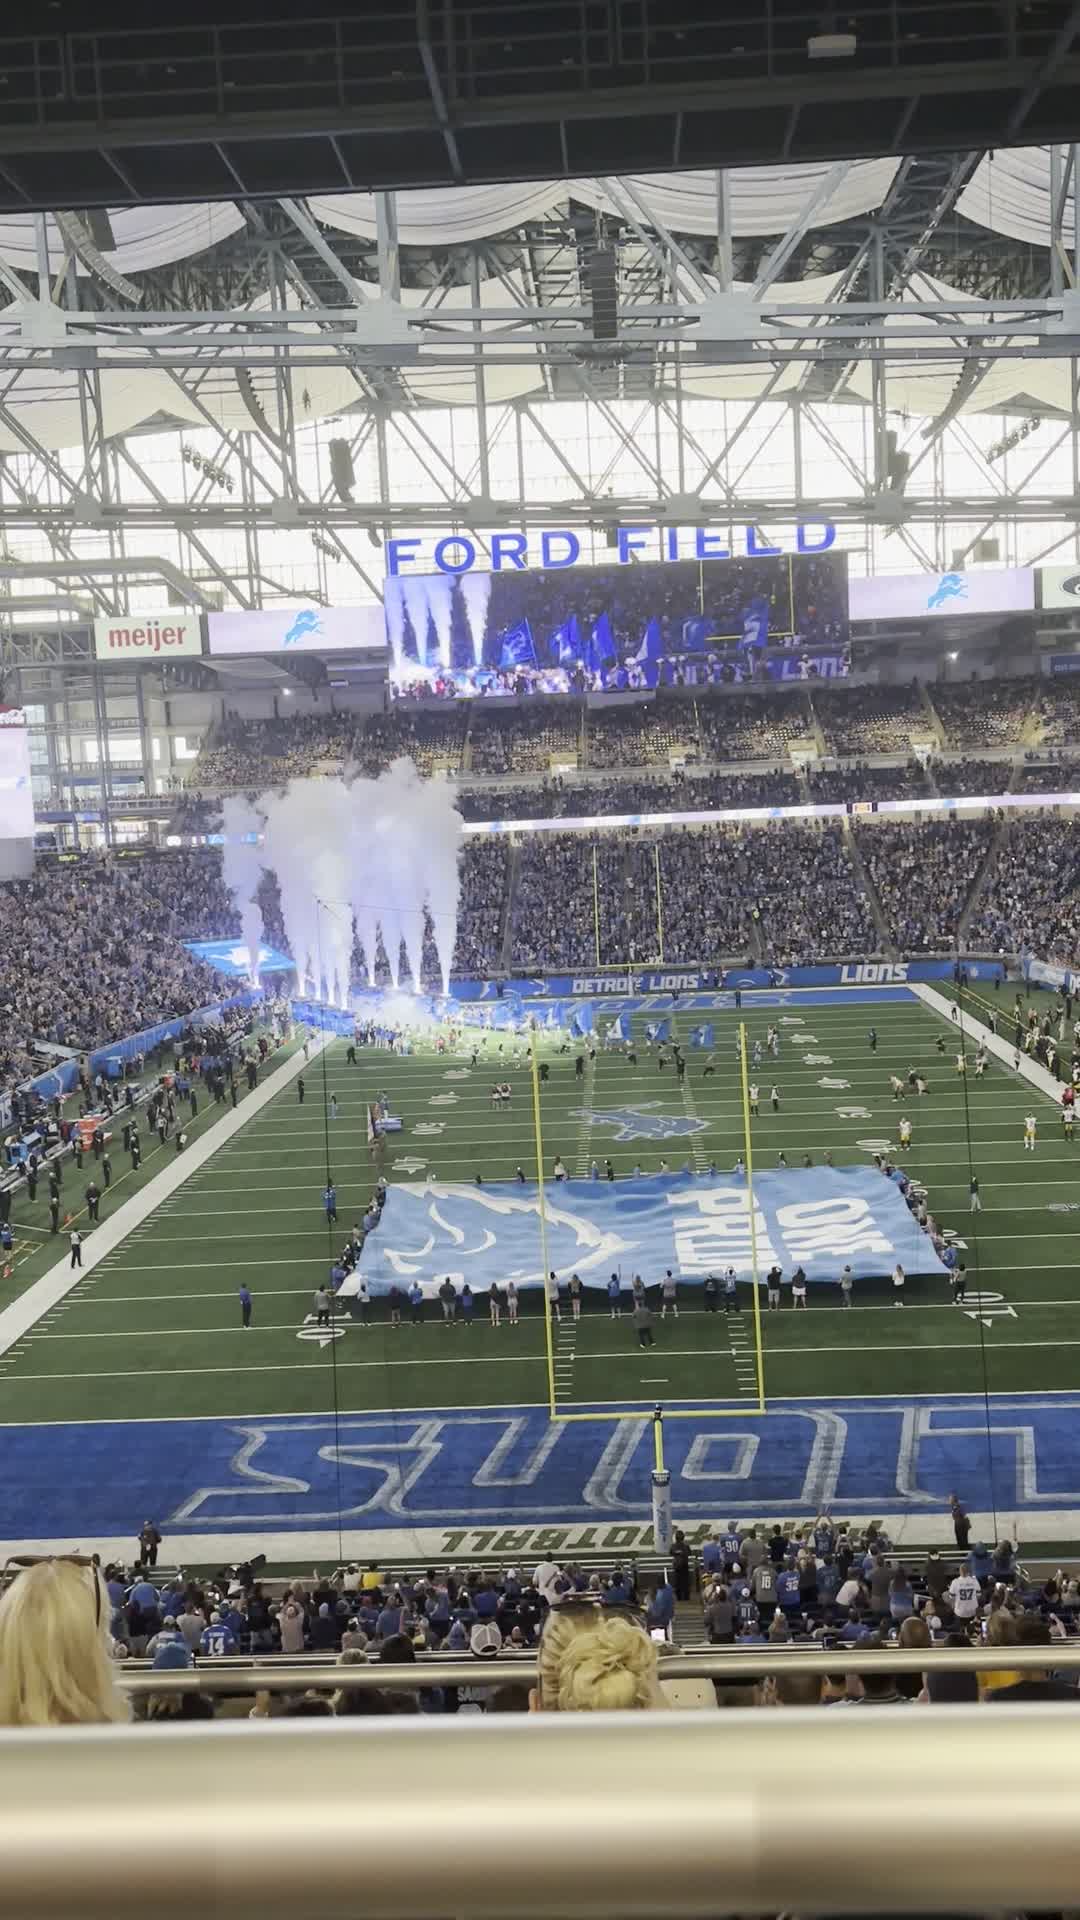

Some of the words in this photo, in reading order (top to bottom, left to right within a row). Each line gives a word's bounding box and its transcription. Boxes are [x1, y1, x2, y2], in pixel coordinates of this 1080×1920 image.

[386, 530, 581, 577] FORD
[617, 517, 837, 565] FIELD
[108, 621, 187, 652] meijer
[649, 975, 699, 991] LIONS
[840, 963, 910, 983] LIONS
[725, 1540, 739, 1553] 90
[959, 1588, 975, 1601] 97
[207, 1637, 225, 1657] 14
